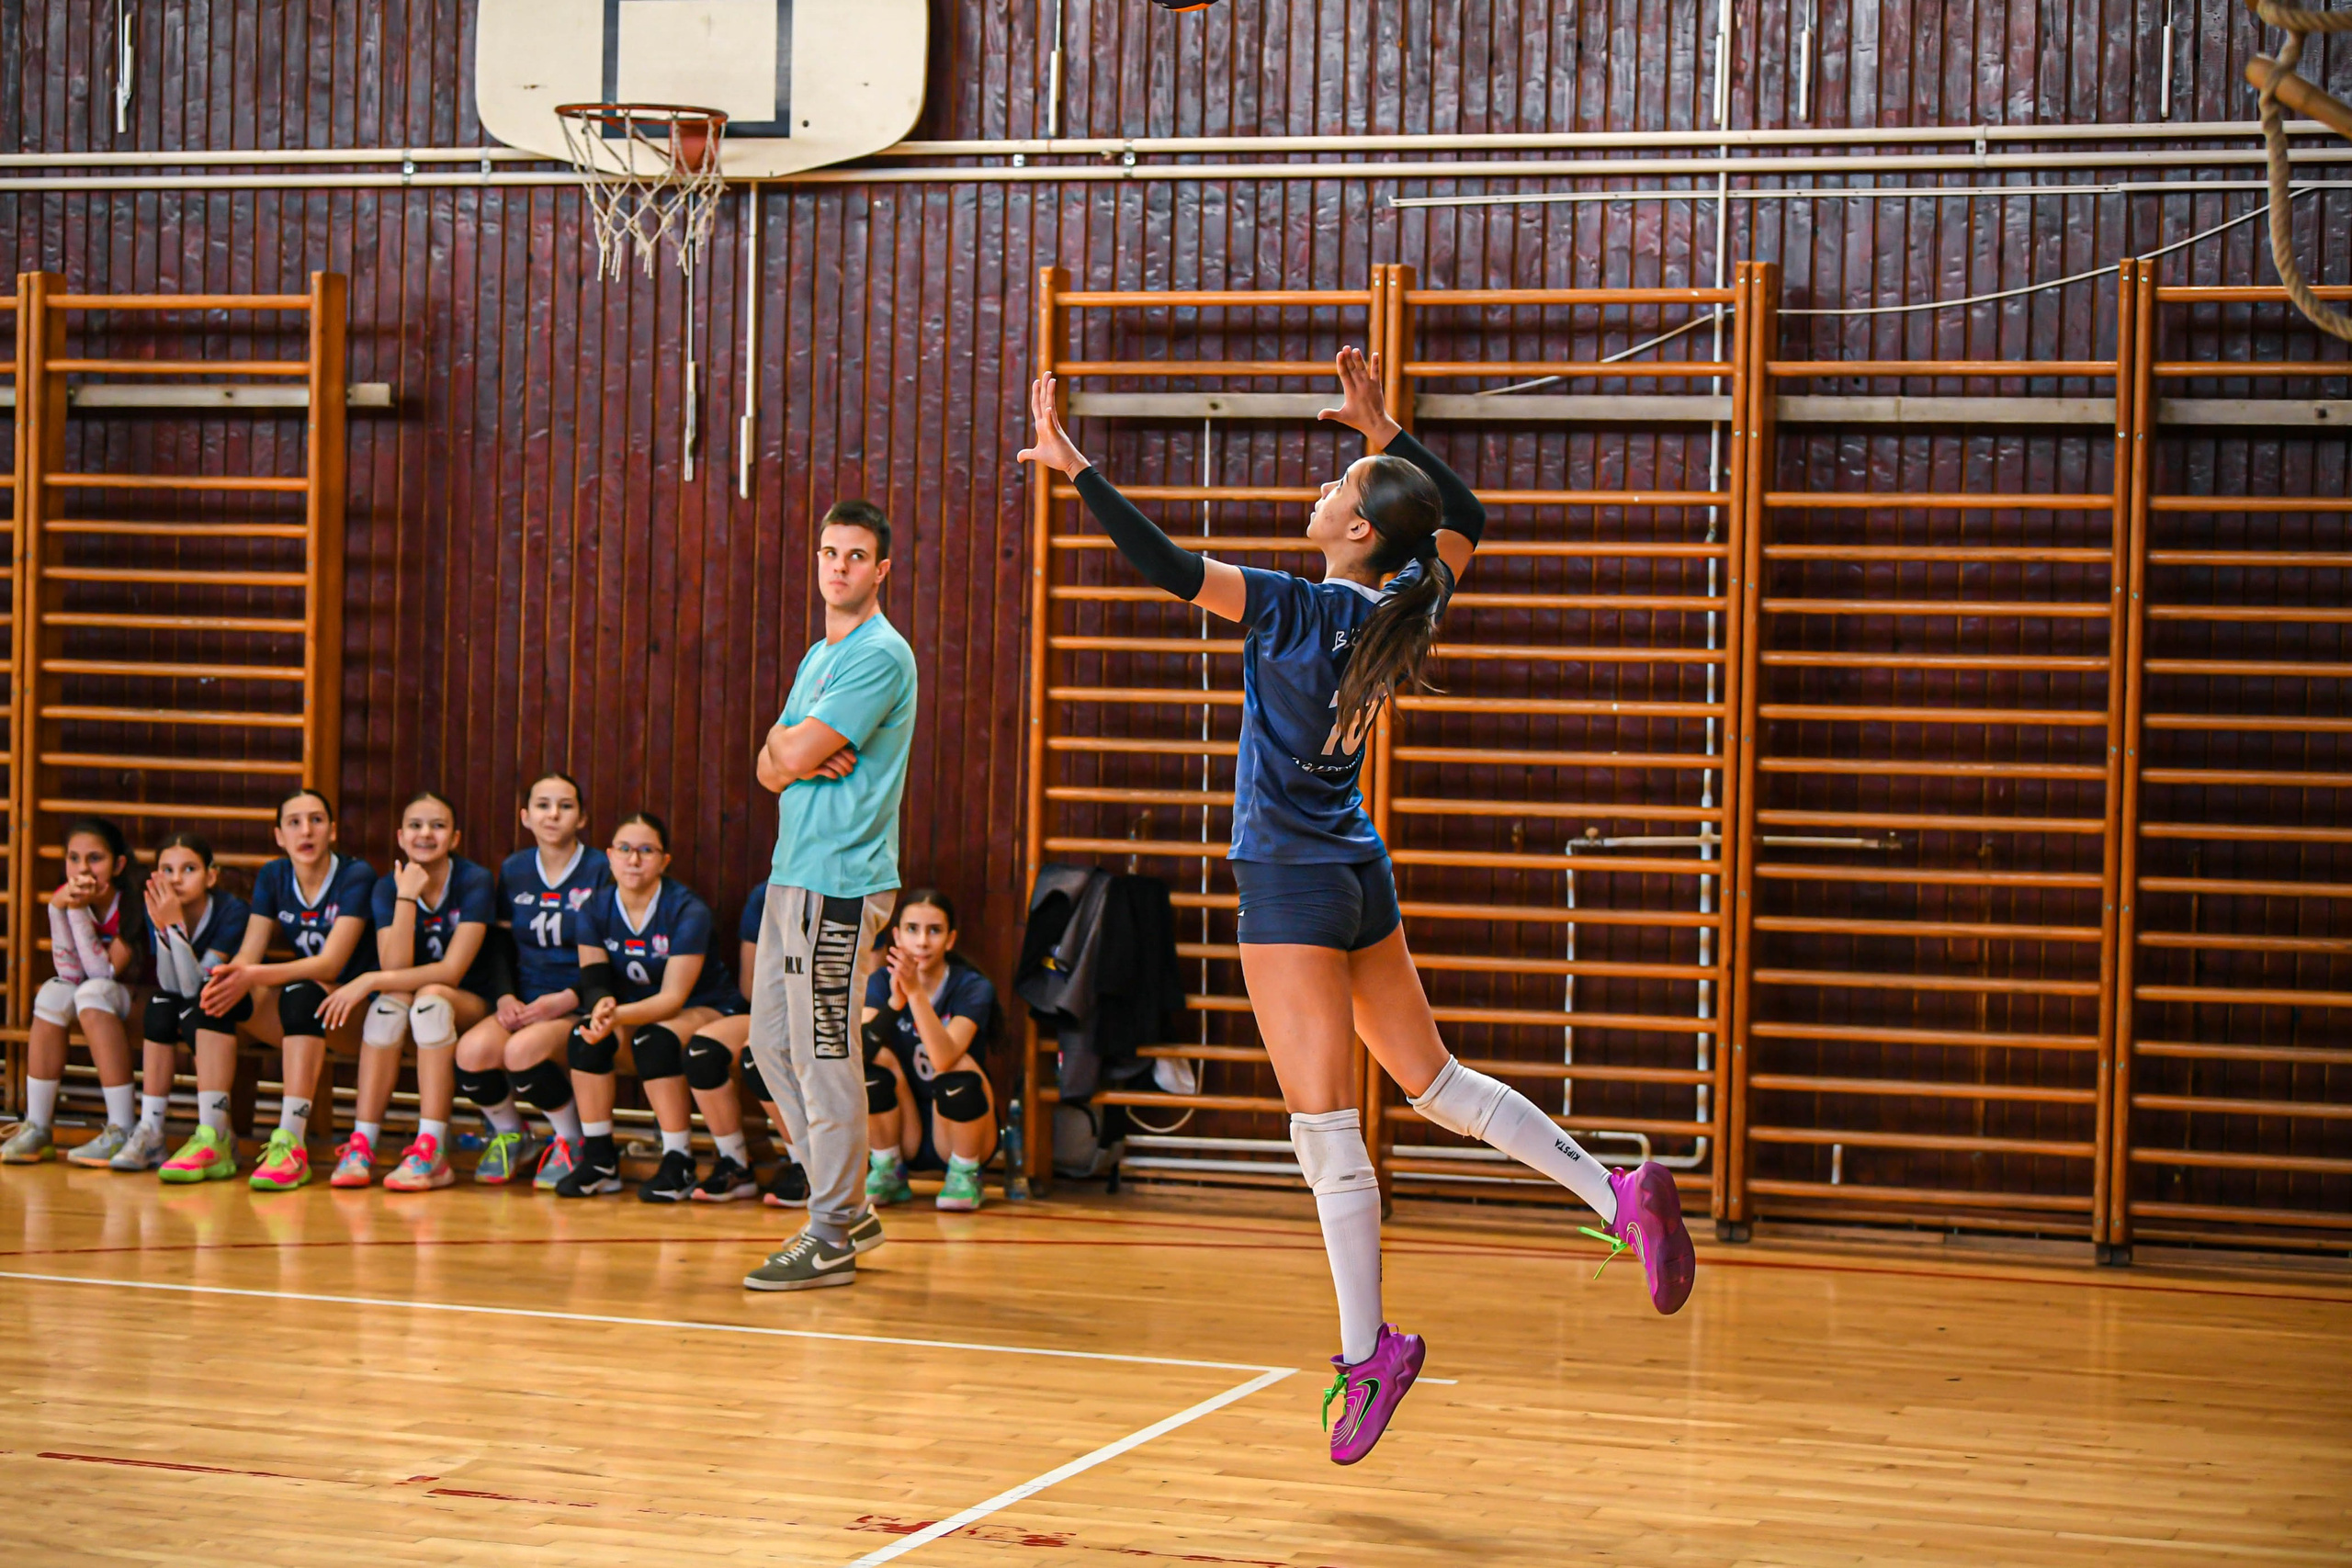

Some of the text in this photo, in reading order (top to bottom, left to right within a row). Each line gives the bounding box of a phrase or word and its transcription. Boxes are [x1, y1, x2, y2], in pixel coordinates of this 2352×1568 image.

[529, 910, 562, 948] 11
[785, 955, 804, 975] M.V.
[815, 919, 858, 1056] BLOCK VOLLEY
[913, 1043, 935, 1079] 6
[1555, 1138, 1581, 1162] KIPSTA
